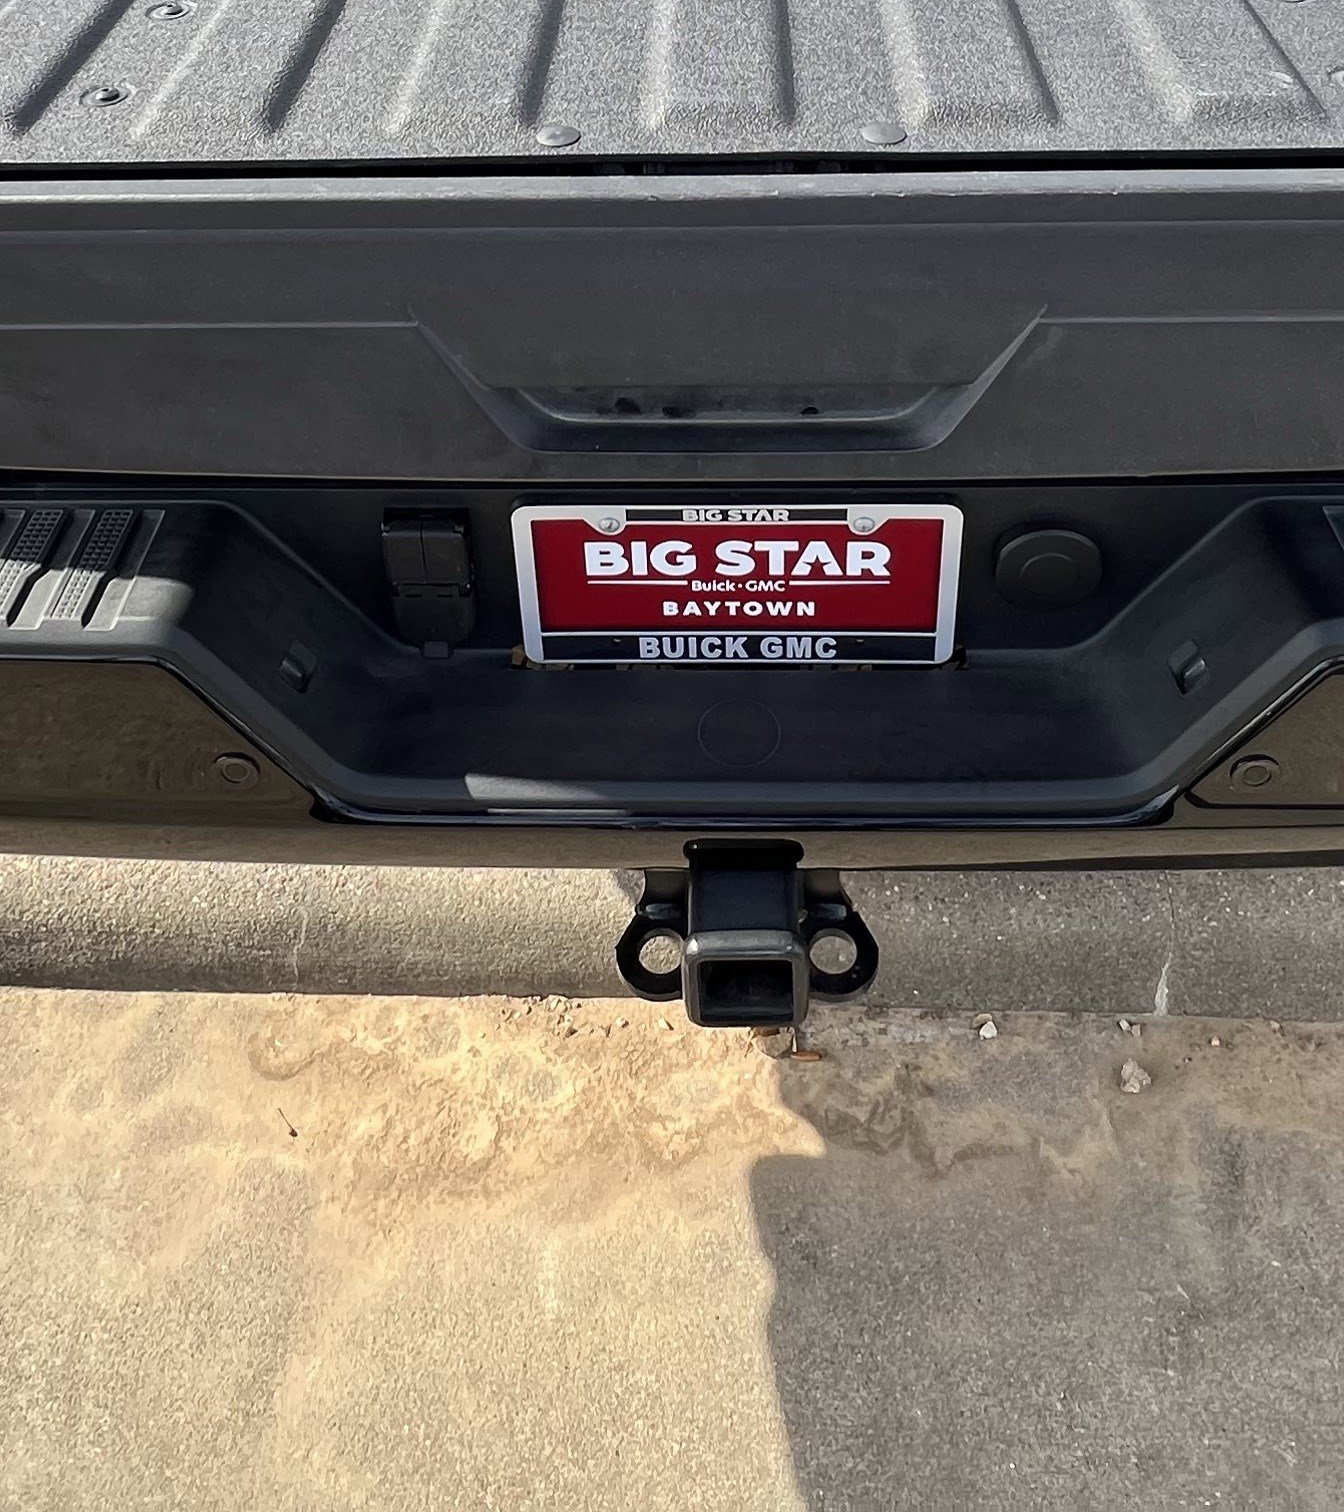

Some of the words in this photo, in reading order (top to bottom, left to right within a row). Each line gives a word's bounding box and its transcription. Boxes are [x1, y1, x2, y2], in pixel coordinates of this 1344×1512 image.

[682, 509, 723, 522] BIG
[727, 509, 789, 522] STAR
[583, 541, 697, 577] BIG
[715, 540, 892, 577] STAR
[745, 581, 786, 593] GMC
[663, 601, 816, 617] BAYTOWN
[639, 637, 748, 659] BUICK
[760, 637, 837, 659] GMC
